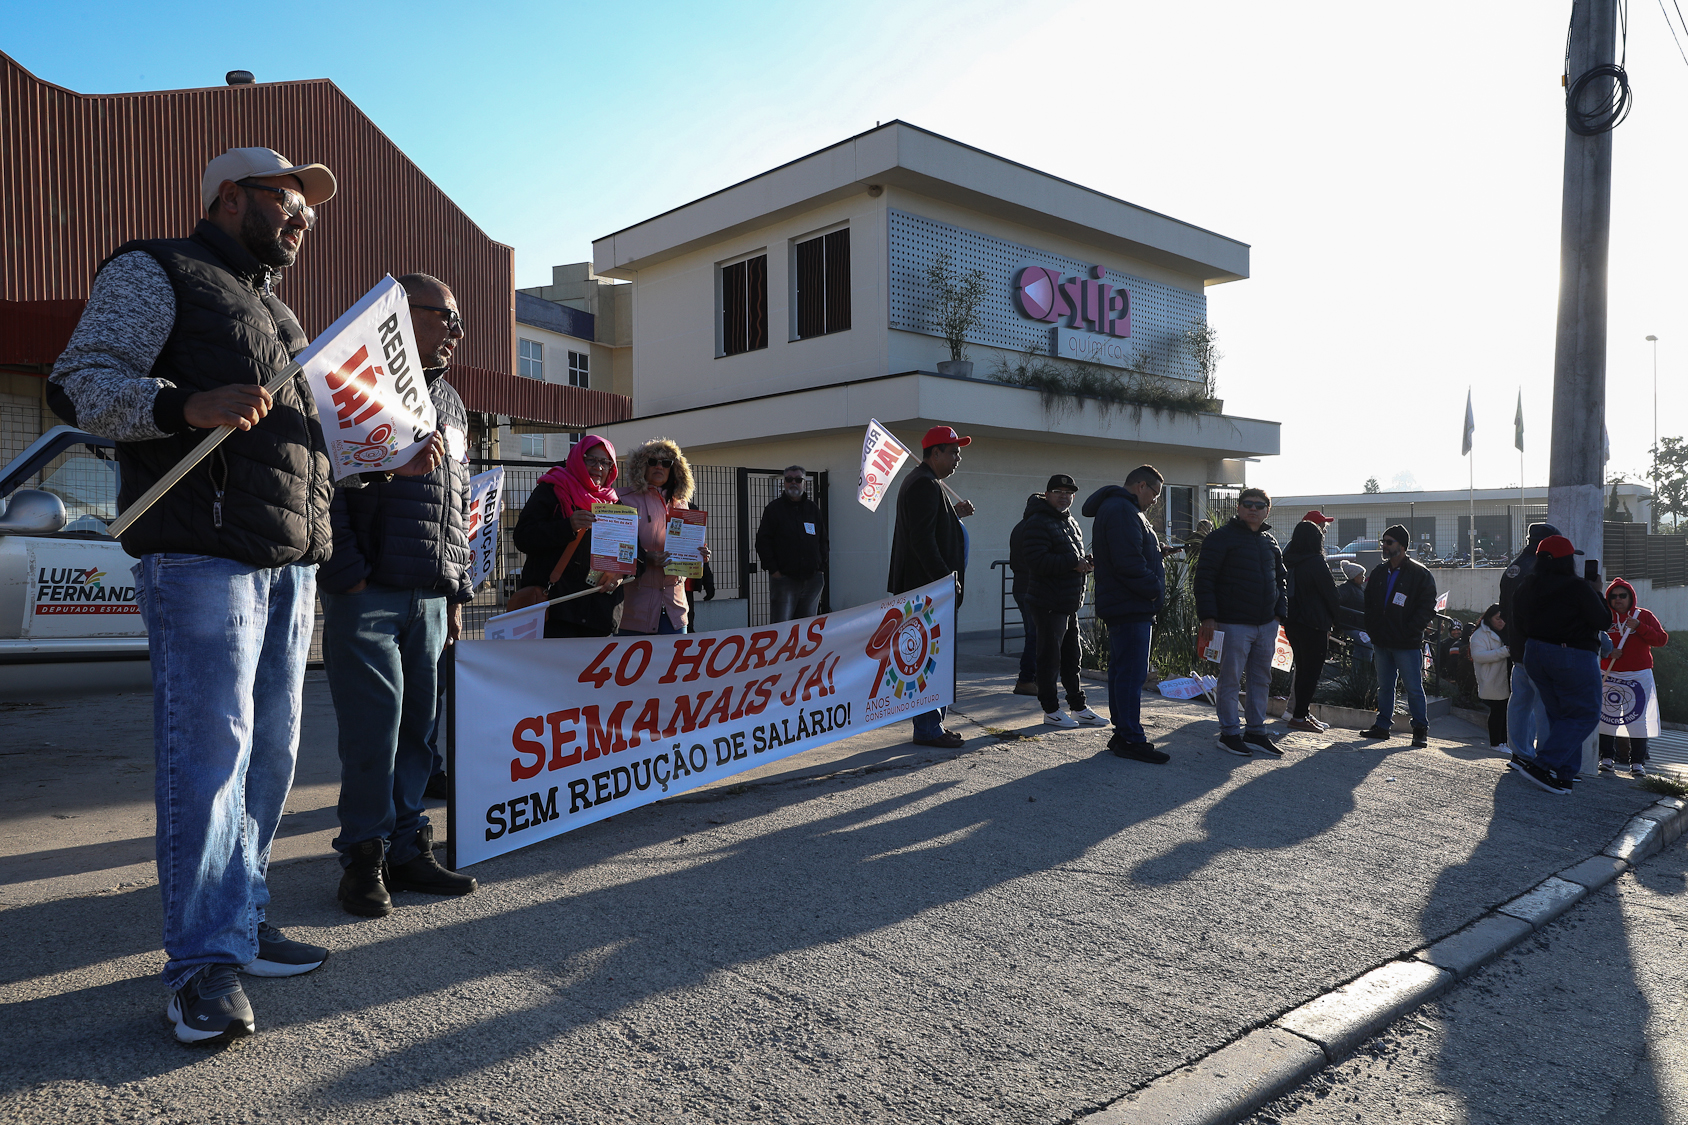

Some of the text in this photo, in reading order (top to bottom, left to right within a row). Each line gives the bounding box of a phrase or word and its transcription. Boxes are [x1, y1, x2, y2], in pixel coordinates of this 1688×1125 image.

[325, 344, 385, 430] JÁ!
[482, 488, 498, 574] REDUÇÃO
[38, 567, 87, 585] LUIZ
[36, 585, 136, 602] FERNAND
[577, 616, 828, 690] 40 HORAS
[903, 662, 919, 674] ABC
[510, 651, 841, 783] SEMANAIS JÁ!
[865, 696, 890, 713] ANOS
[865, 693, 940, 723] CONSTRUINDO O FUTURO
[1625, 711, 1639, 722] ABC
[484, 701, 852, 843] SEM REDUÇÃO DE SALÁRIO!
